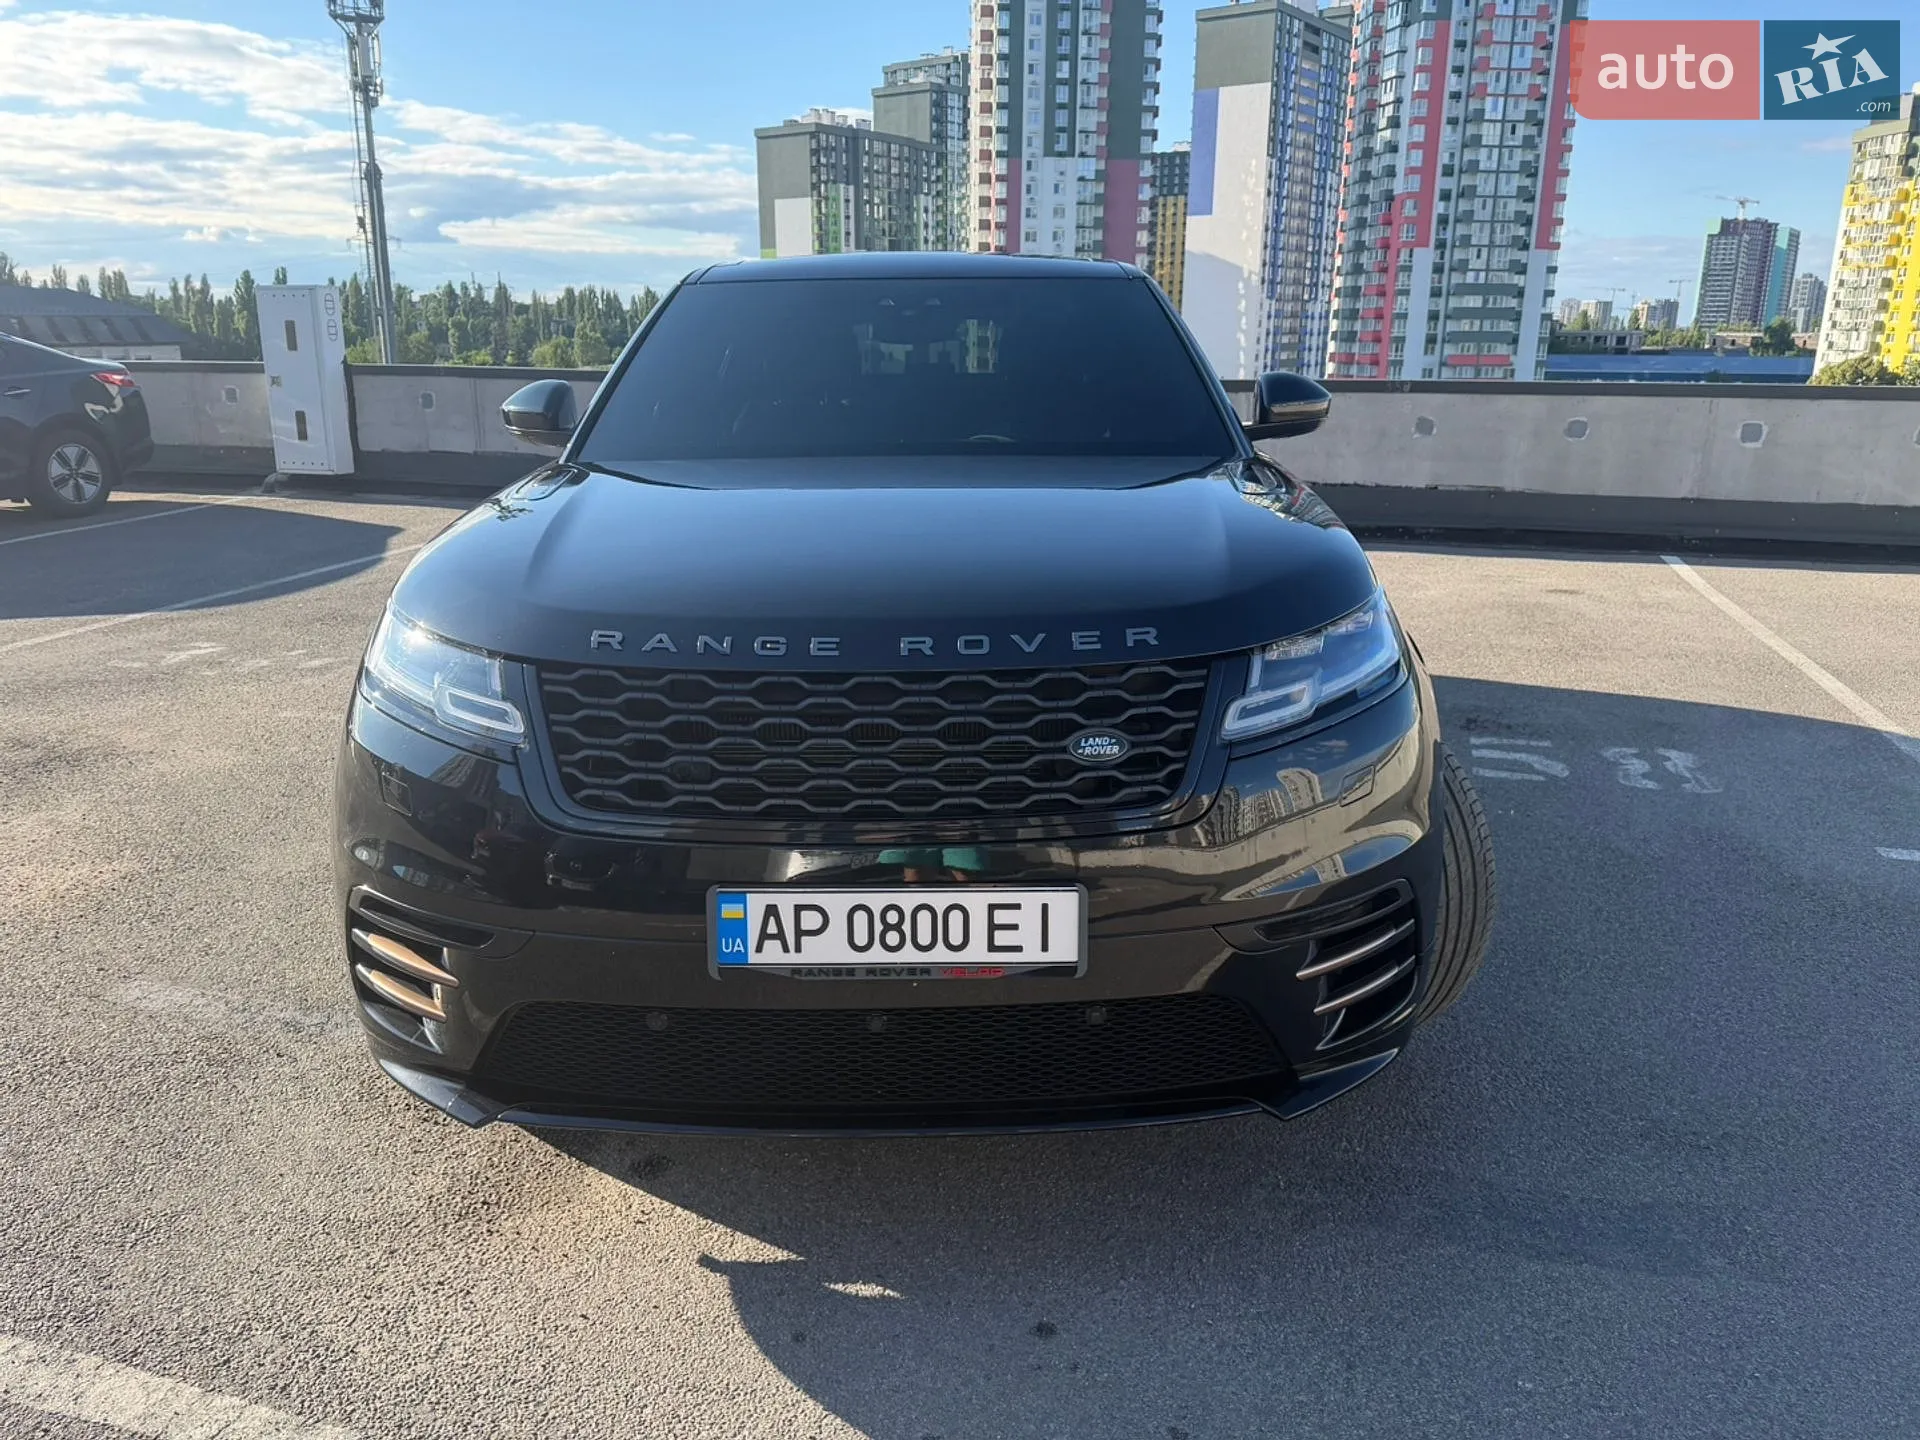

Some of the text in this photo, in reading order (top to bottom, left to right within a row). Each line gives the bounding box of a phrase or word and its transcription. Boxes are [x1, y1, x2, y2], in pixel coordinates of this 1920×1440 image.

[590, 626, 1160, 656] RANGE ROVER
[754, 902, 1050, 954] AP 0800 EI
[721, 937, 745, 953] UA
[790, 967, 857, 979] RANGE
[865, 967, 932, 978] ROVER
